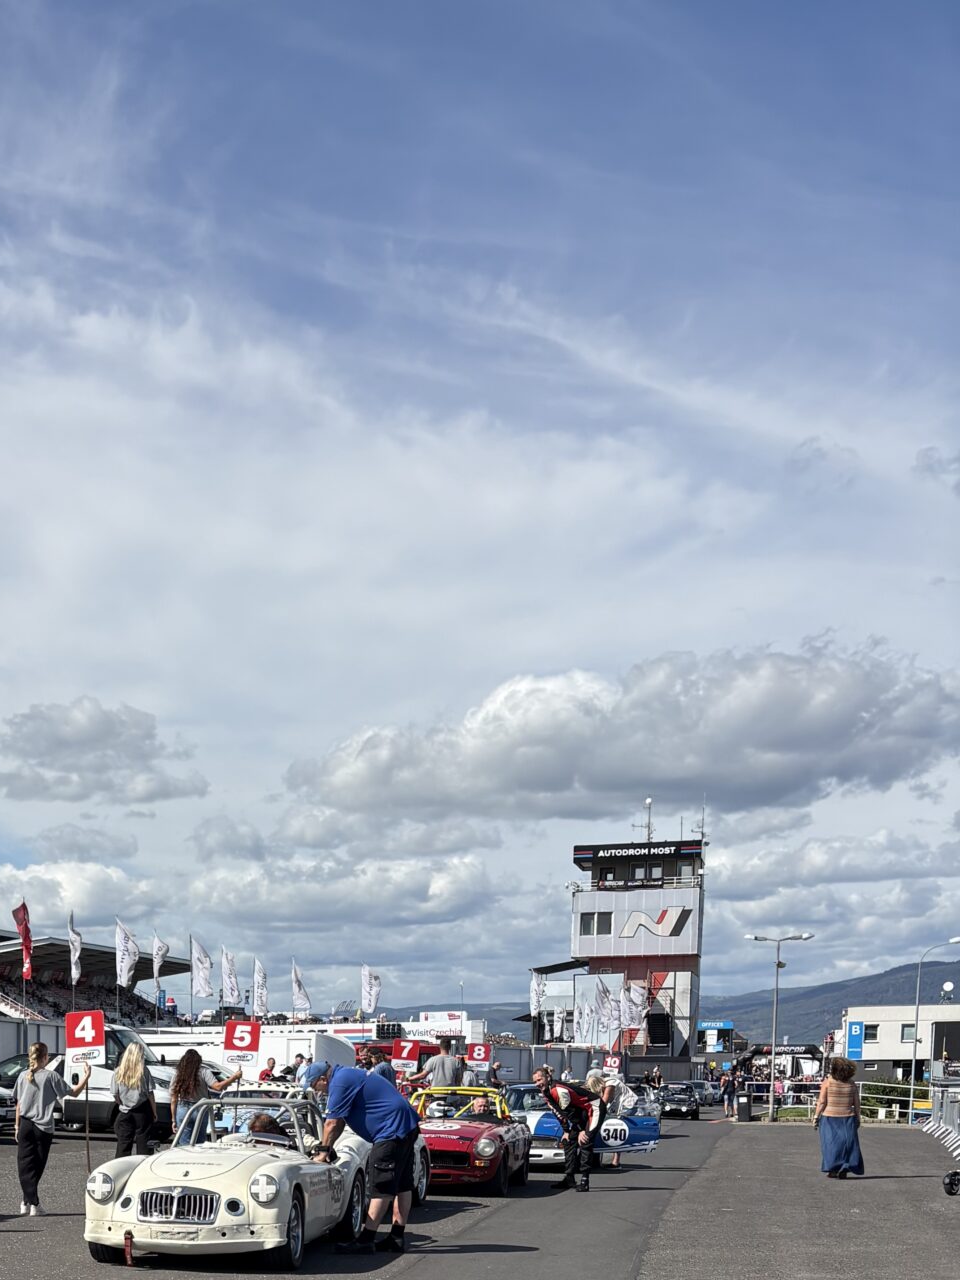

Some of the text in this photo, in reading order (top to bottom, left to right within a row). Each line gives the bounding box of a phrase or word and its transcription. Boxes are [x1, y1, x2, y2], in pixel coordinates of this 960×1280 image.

[598, 846, 676, 857] AUTODROM MOST
[74, 1015, 96, 1043] 4
[232, 1024, 252, 1048] 5
[851, 1025, 861, 1035] B
[400, 1041, 414, 1058] 7
[472, 1045, 486, 1060] 8
[605, 1057, 620, 1068] 10
[602, 1128, 627, 1142] 340
